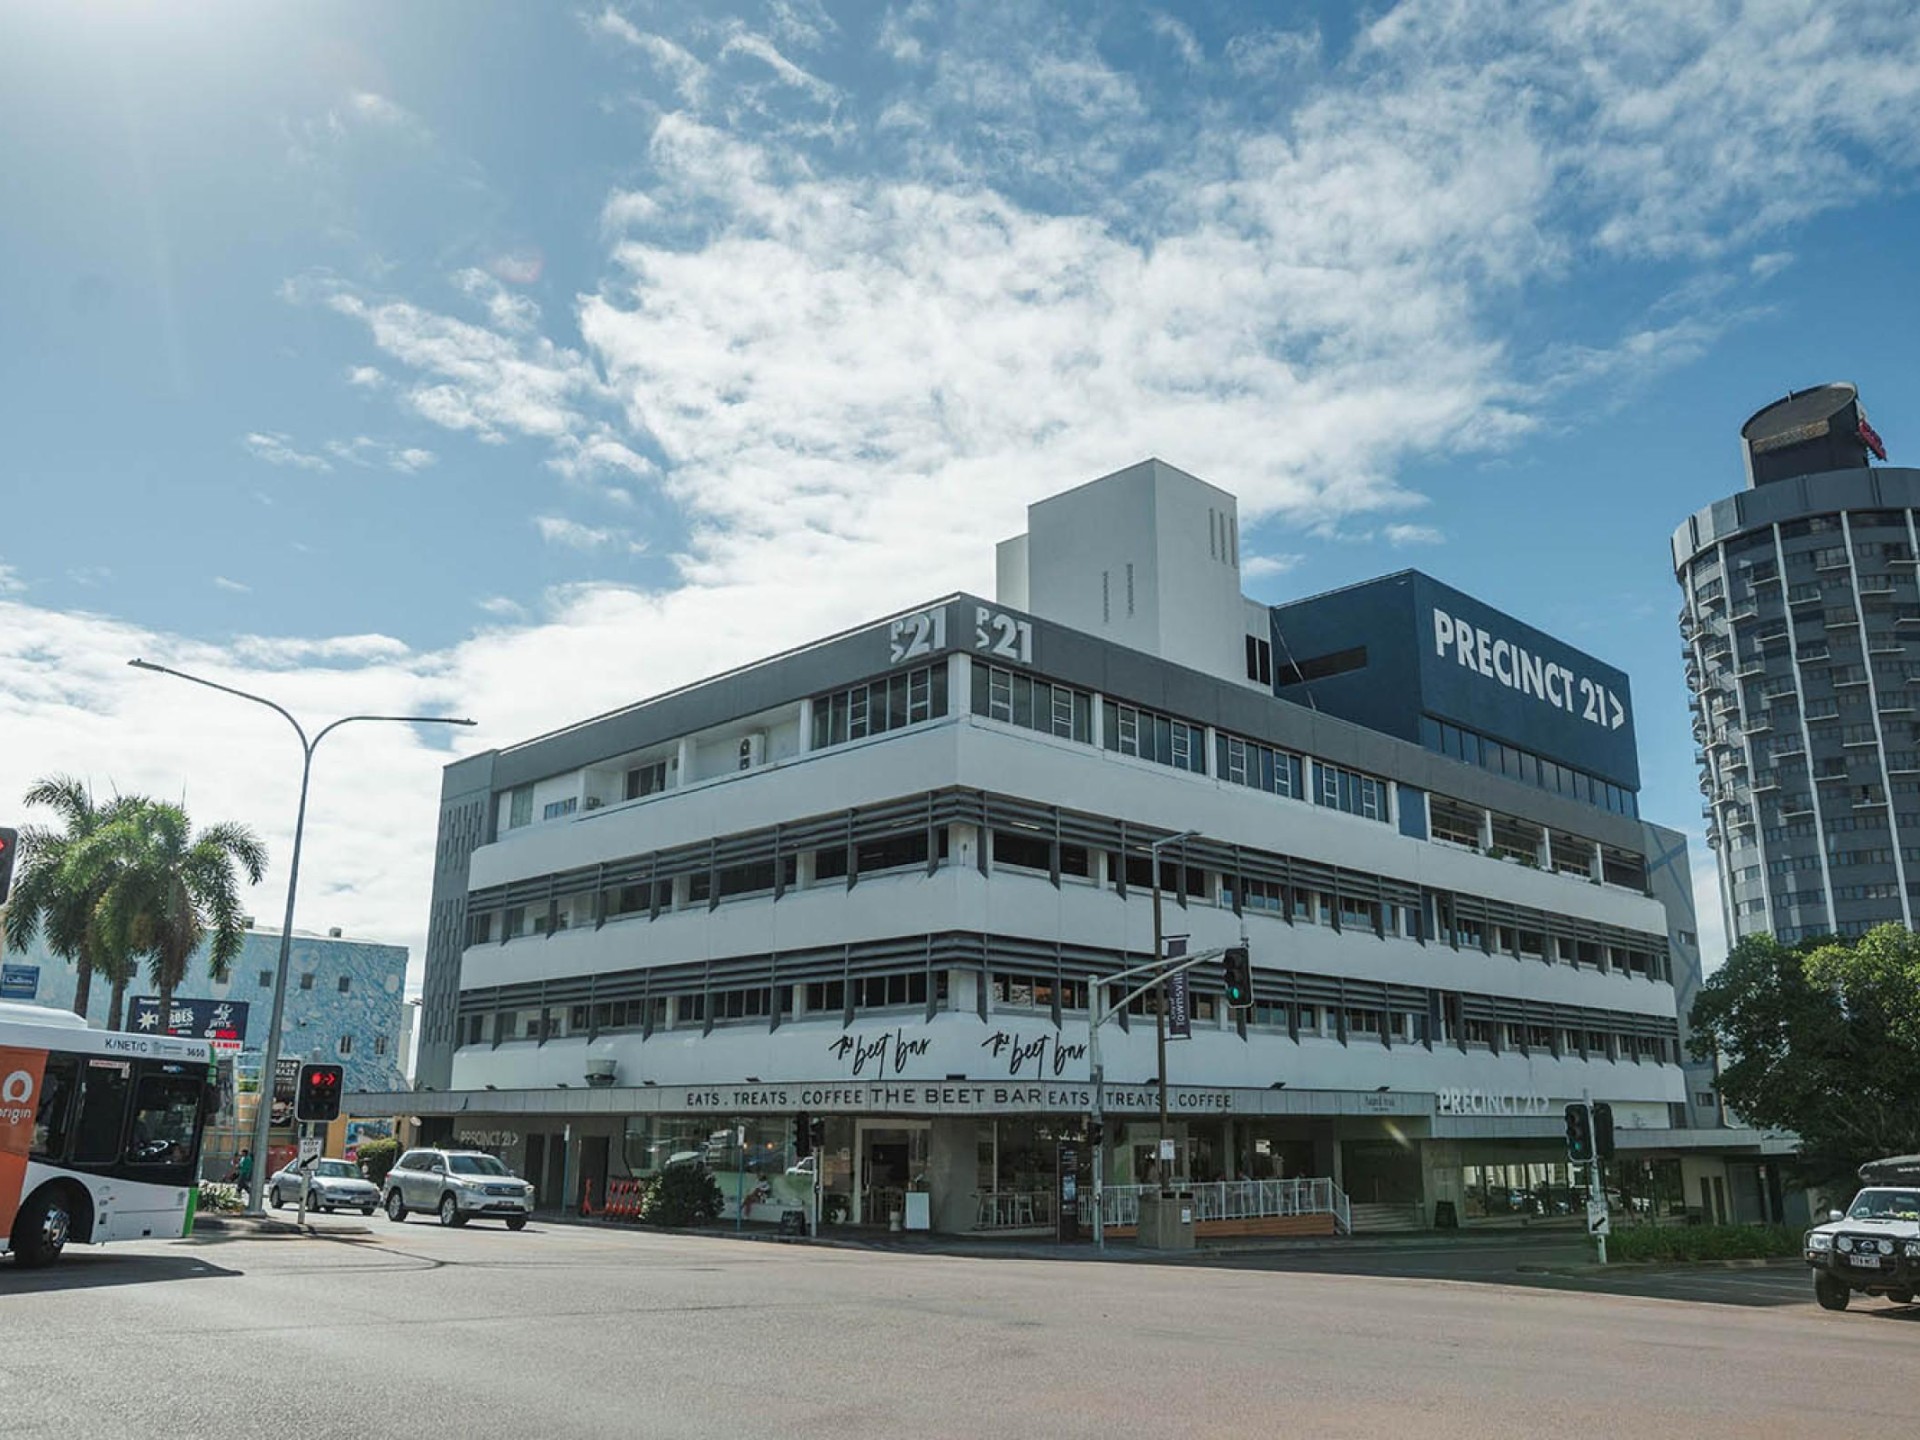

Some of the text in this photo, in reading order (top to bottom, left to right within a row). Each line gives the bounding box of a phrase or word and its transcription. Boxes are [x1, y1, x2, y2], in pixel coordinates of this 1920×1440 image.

[903, 606, 947, 660] 21
[992, 613, 1033, 664] 21
[1433, 608, 1575, 713] PRECINCT
[1174, 971, 1186, 1026] Townsvill
[852, 1032, 893, 1080] beet
[895, 1027, 931, 1074] bar
[1009, 1033, 1051, 1080] beet
[1054, 1031, 1087, 1076] bar
[687, 1090, 863, 1106] EATS TREATS COFFEE
[871, 1088, 1042, 1104] THE BEET BAR
[1048, 1091, 1232, 1108] EATS TREATS COFFEE
[1438, 1088, 1517, 1115] PRECINCT
